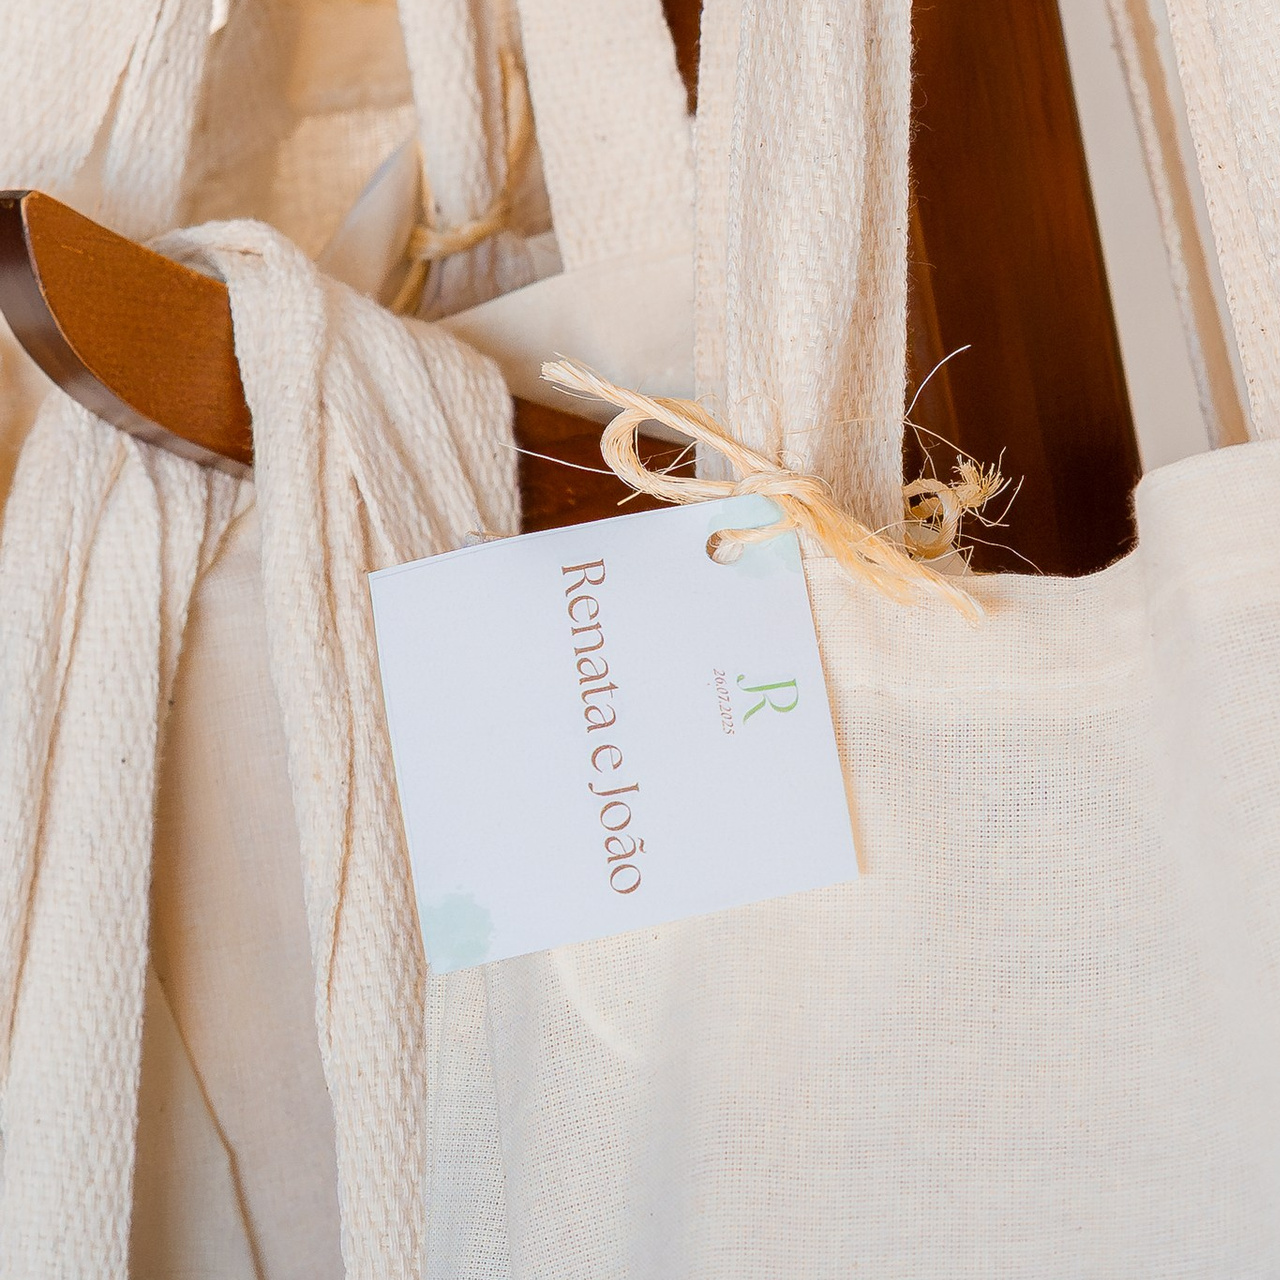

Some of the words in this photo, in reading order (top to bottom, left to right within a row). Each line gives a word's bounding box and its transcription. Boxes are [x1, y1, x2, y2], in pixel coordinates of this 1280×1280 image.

[561, 558, 619, 734] Renata
[713, 668, 735, 735] 26.07.2025
[736, 674, 799, 725] JR
[590, 743, 623, 773] e
[588, 781, 647, 895] João
